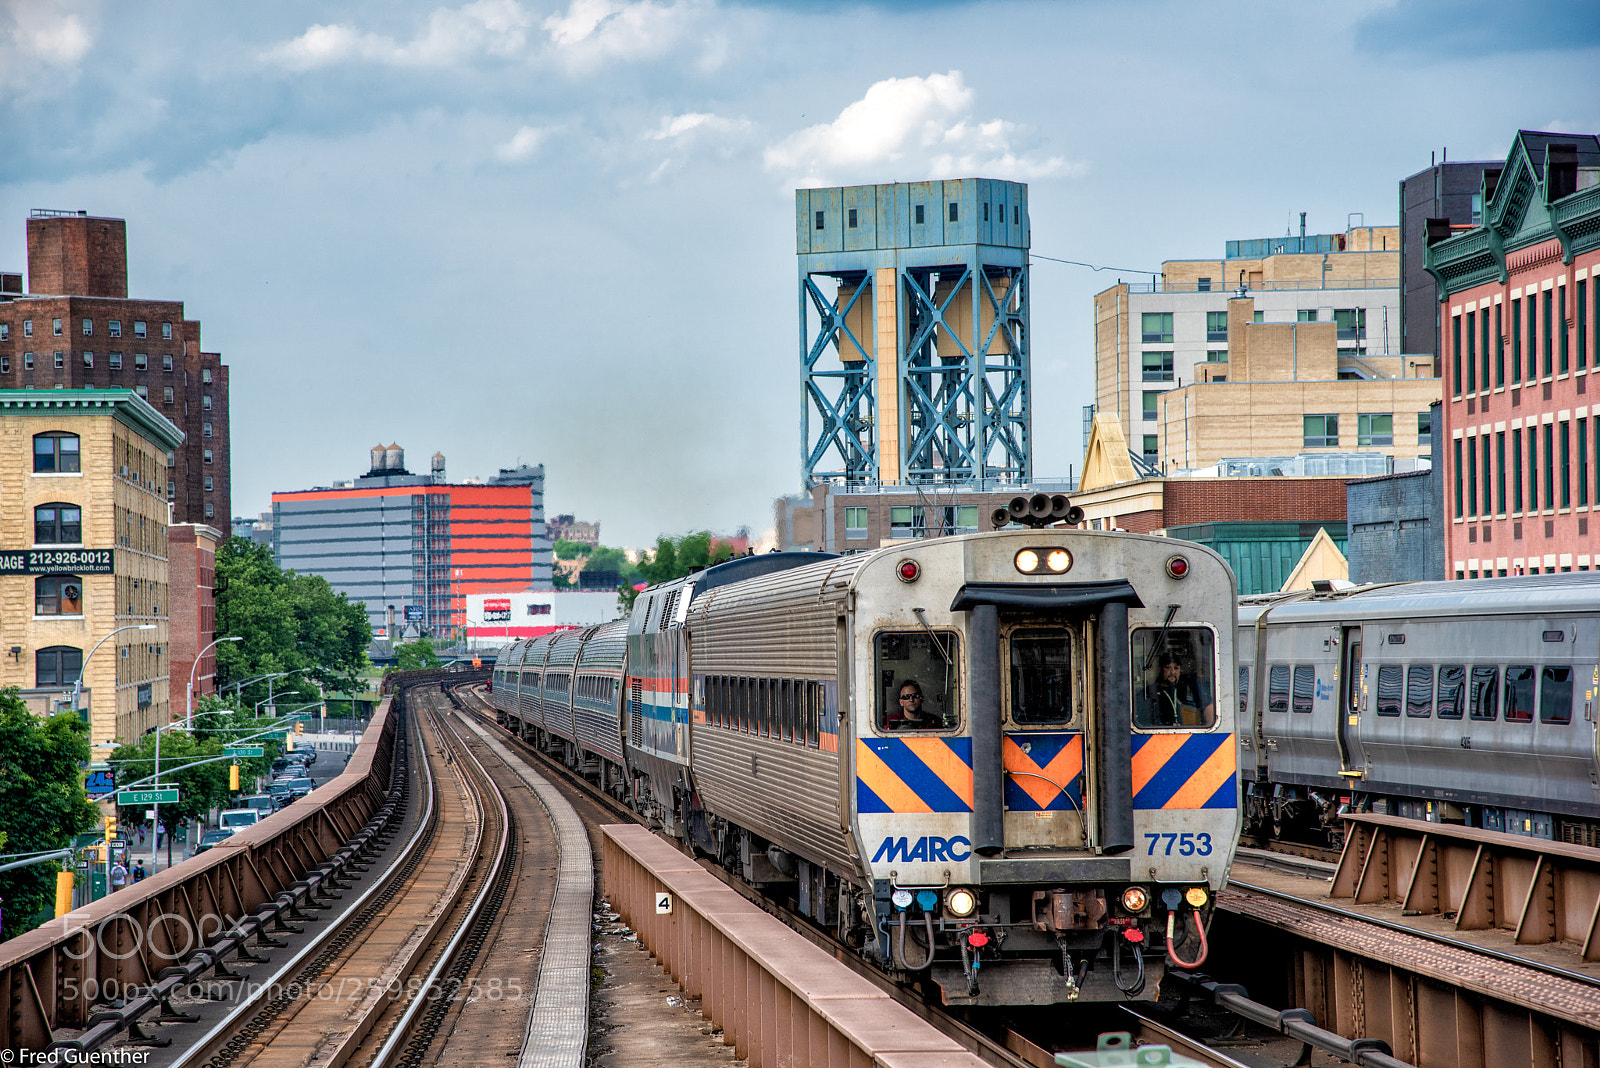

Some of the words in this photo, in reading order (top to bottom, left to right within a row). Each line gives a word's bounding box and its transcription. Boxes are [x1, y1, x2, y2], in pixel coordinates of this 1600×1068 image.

[29, 552, 110, 564] 212-926-0012
[29, 564, 110, 573] www.yellowbrickloft.com
[86, 772, 105, 786] 24
[871, 835, 972, 862] MARC
[1144, 832, 1213, 856] 7753
[658, 896, 670, 910] 4
